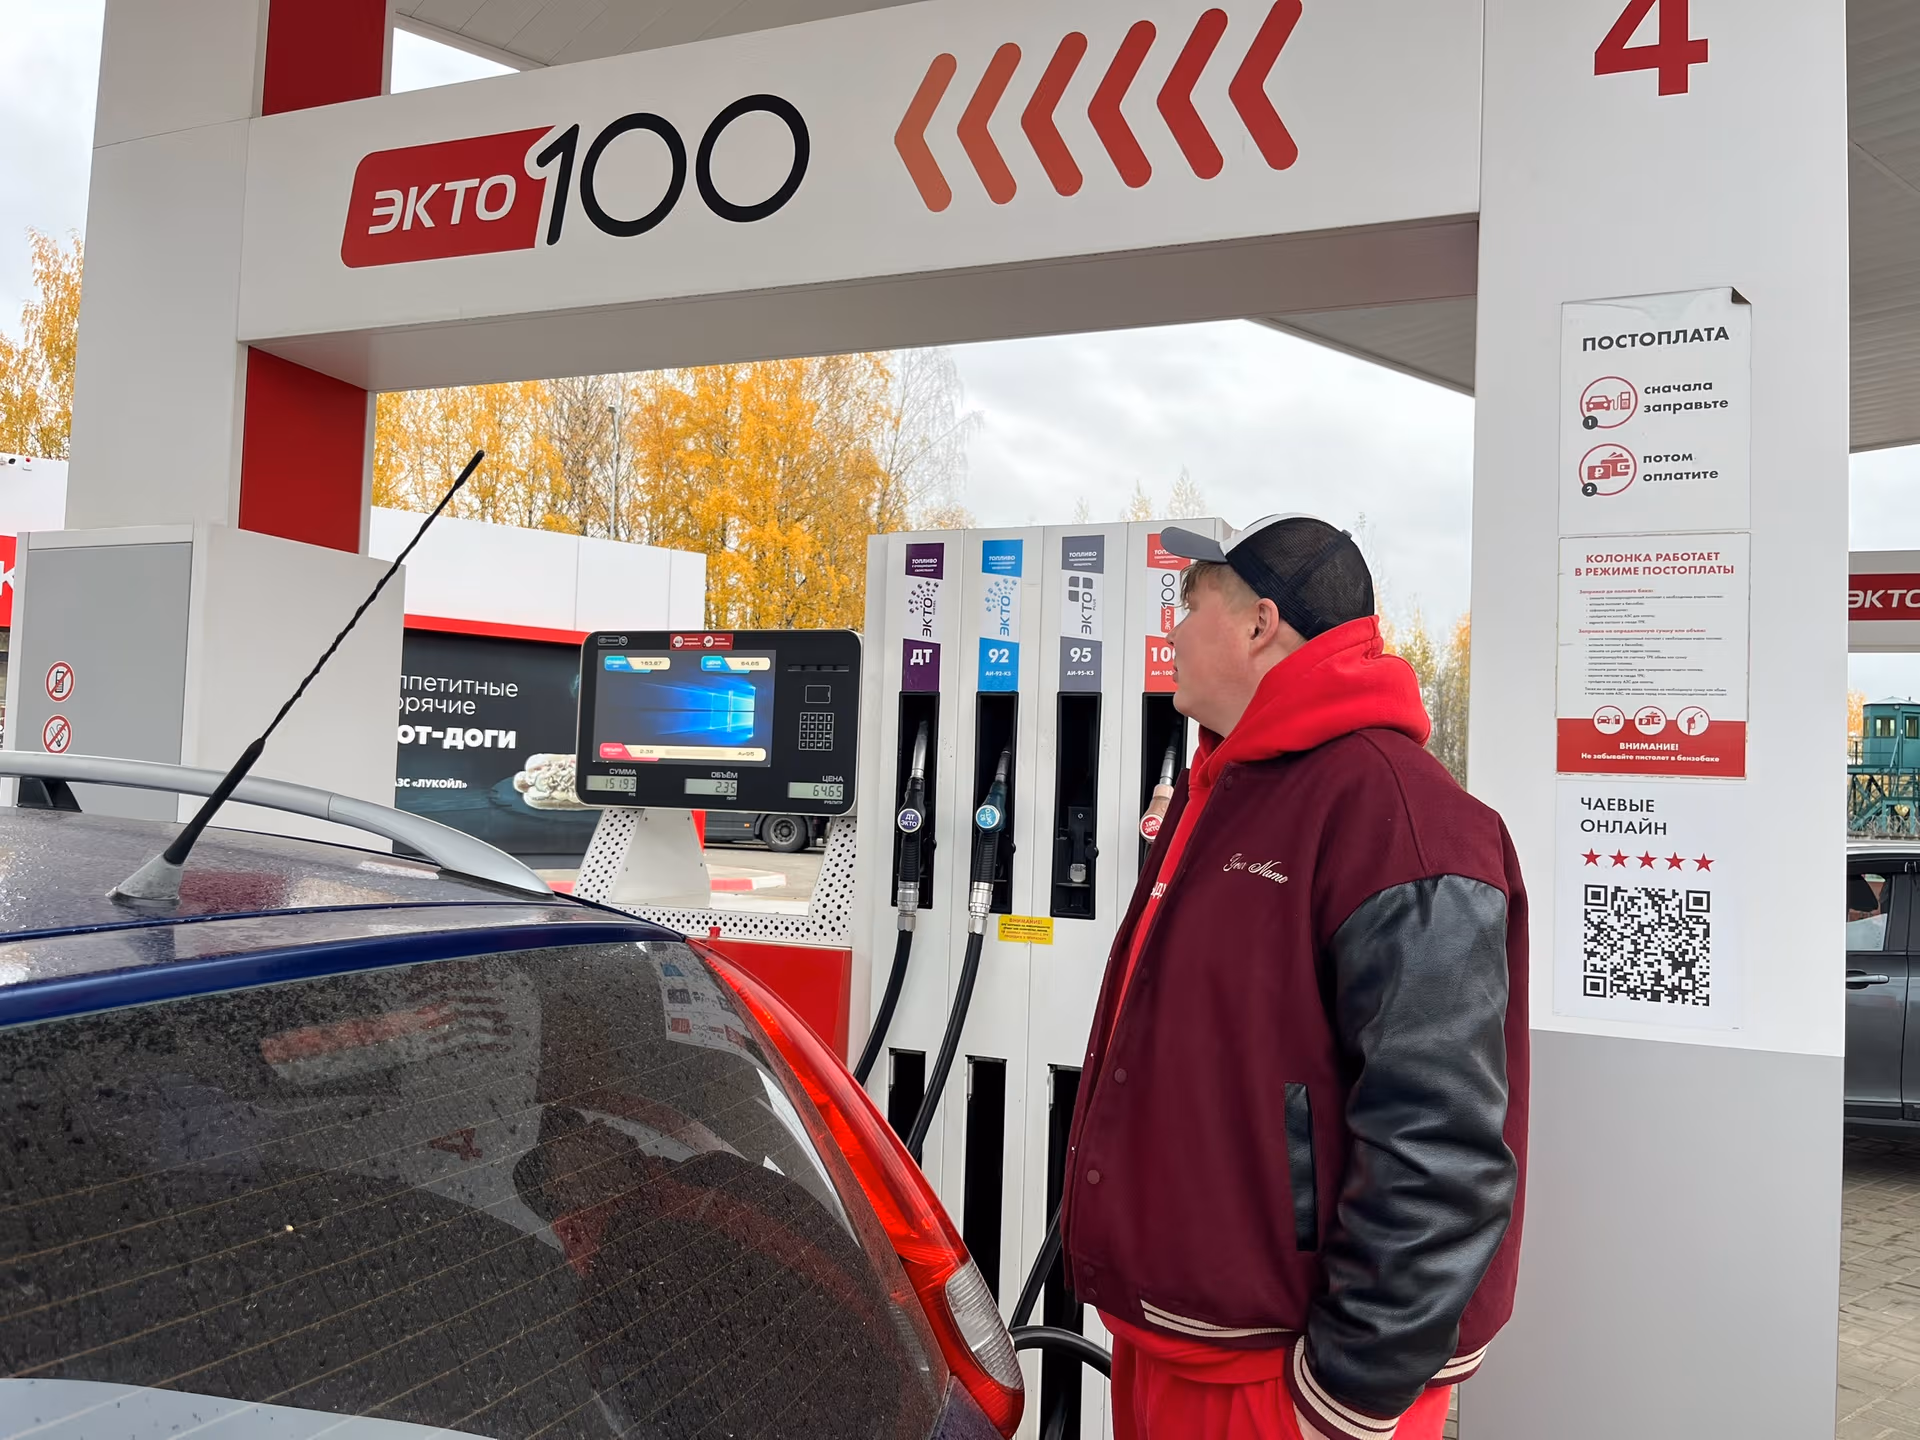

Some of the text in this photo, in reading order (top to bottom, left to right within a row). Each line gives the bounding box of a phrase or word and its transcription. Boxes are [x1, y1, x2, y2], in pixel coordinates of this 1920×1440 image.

[1594, 0, 1708, 96] 4
[368, 93, 811, 246] ЭКТО 100
[1582, 326, 1730, 352] ПОСТОПЛАТА
[1644, 381, 1713, 395] сначала
[1643, 398, 1729, 415] заправьте
[1643, 452, 1693, 464] потом
[1642, 469, 1719, 482] оплатите
[1586, 551, 1720, 564] КОЛОНКА РАБОТАЕТ
[1574, 564, 1735, 577] В РЕЖИМЕ ПОСТОПЛАТЫ
[910, 649, 933, 666] ДТ
[988, 648, 1010, 664] 92
[1069, 647, 1092, 663] 95
[1619, 742, 1679, 751] ВНИМАНИЕ!
[1593, 753, 1634, 761] забывайте
[1677, 754, 1720, 762] бензобаке
[609, 768, 637, 776] СУММА
[711, 771, 738, 779] ОБЪЁМ
[412, 778, 468, 789] «ЛУКОЙЛ»
[822, 775, 844, 784] ЦЕНА
[1581, 797, 1655, 813] ЧАЕВЫЕ
[900, 819, 918, 827] ЭКТО
[905, 813, 916, 821] ДТ
[1580, 817, 1667, 835] ОНЛАЙН
